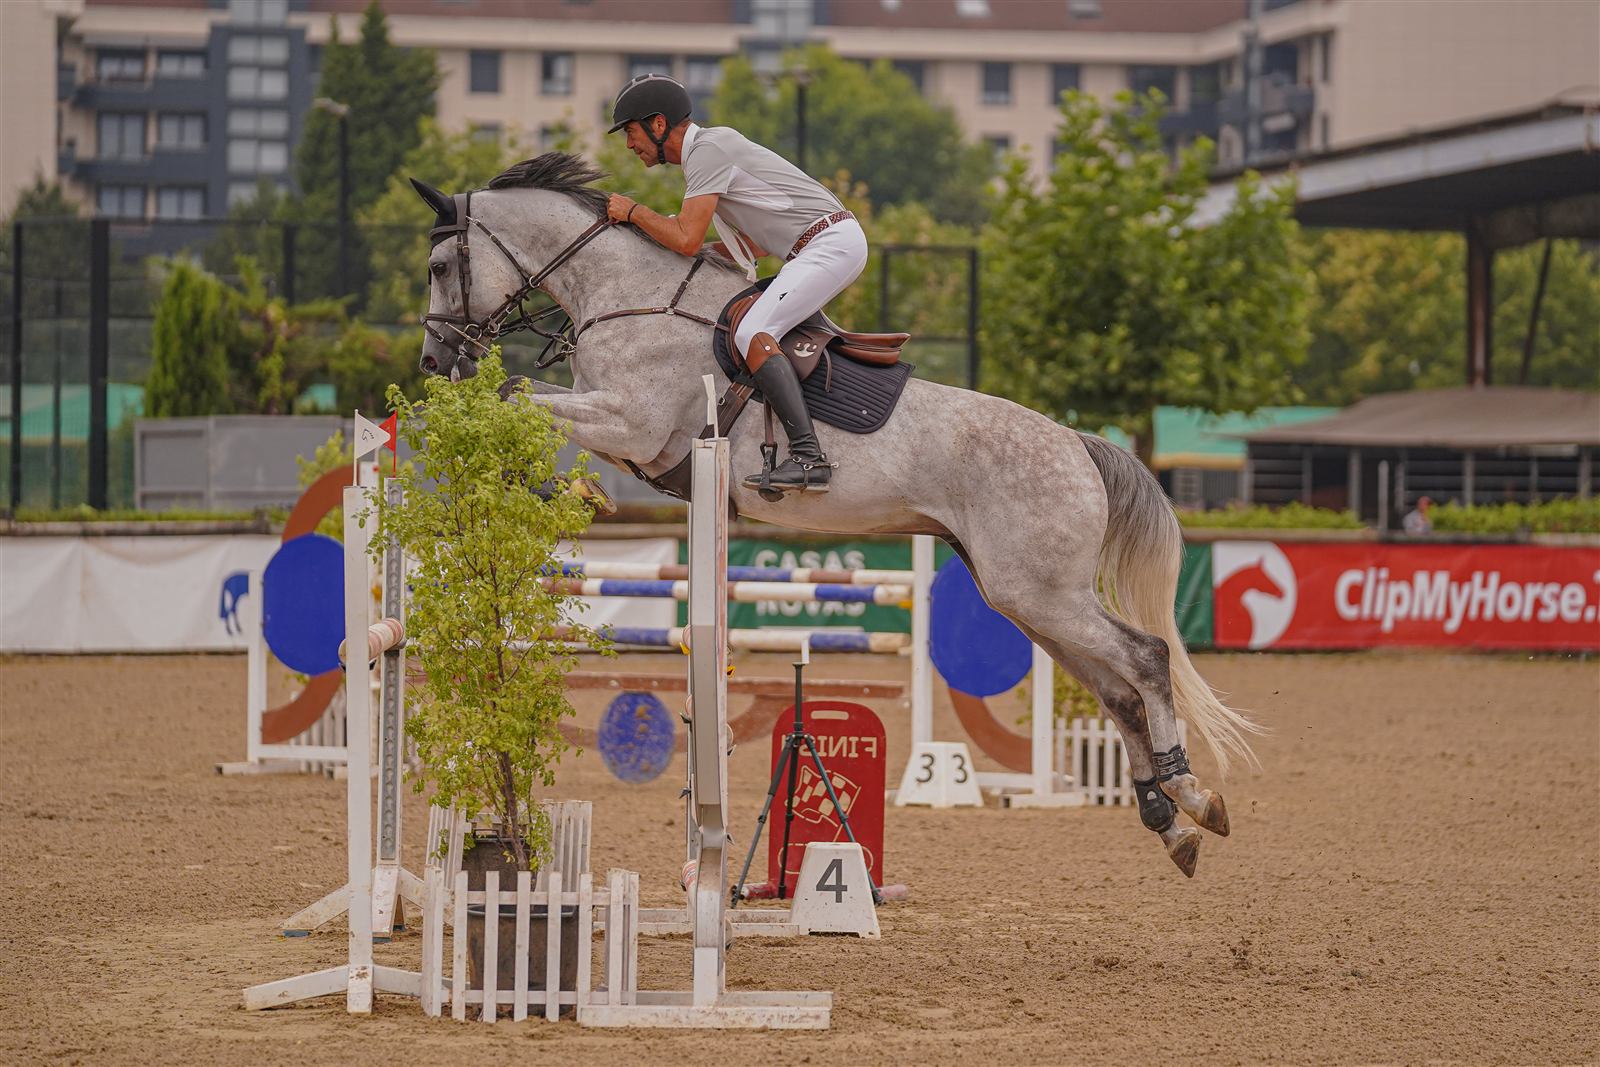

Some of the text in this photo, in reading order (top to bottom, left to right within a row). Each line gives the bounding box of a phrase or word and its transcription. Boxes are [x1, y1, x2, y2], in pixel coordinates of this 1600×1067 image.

[755, 549, 865, 568] CASAS
[915, 753, 935, 783] 3
[952, 753, 968, 784] 3
[815, 858, 848, 904] 4
